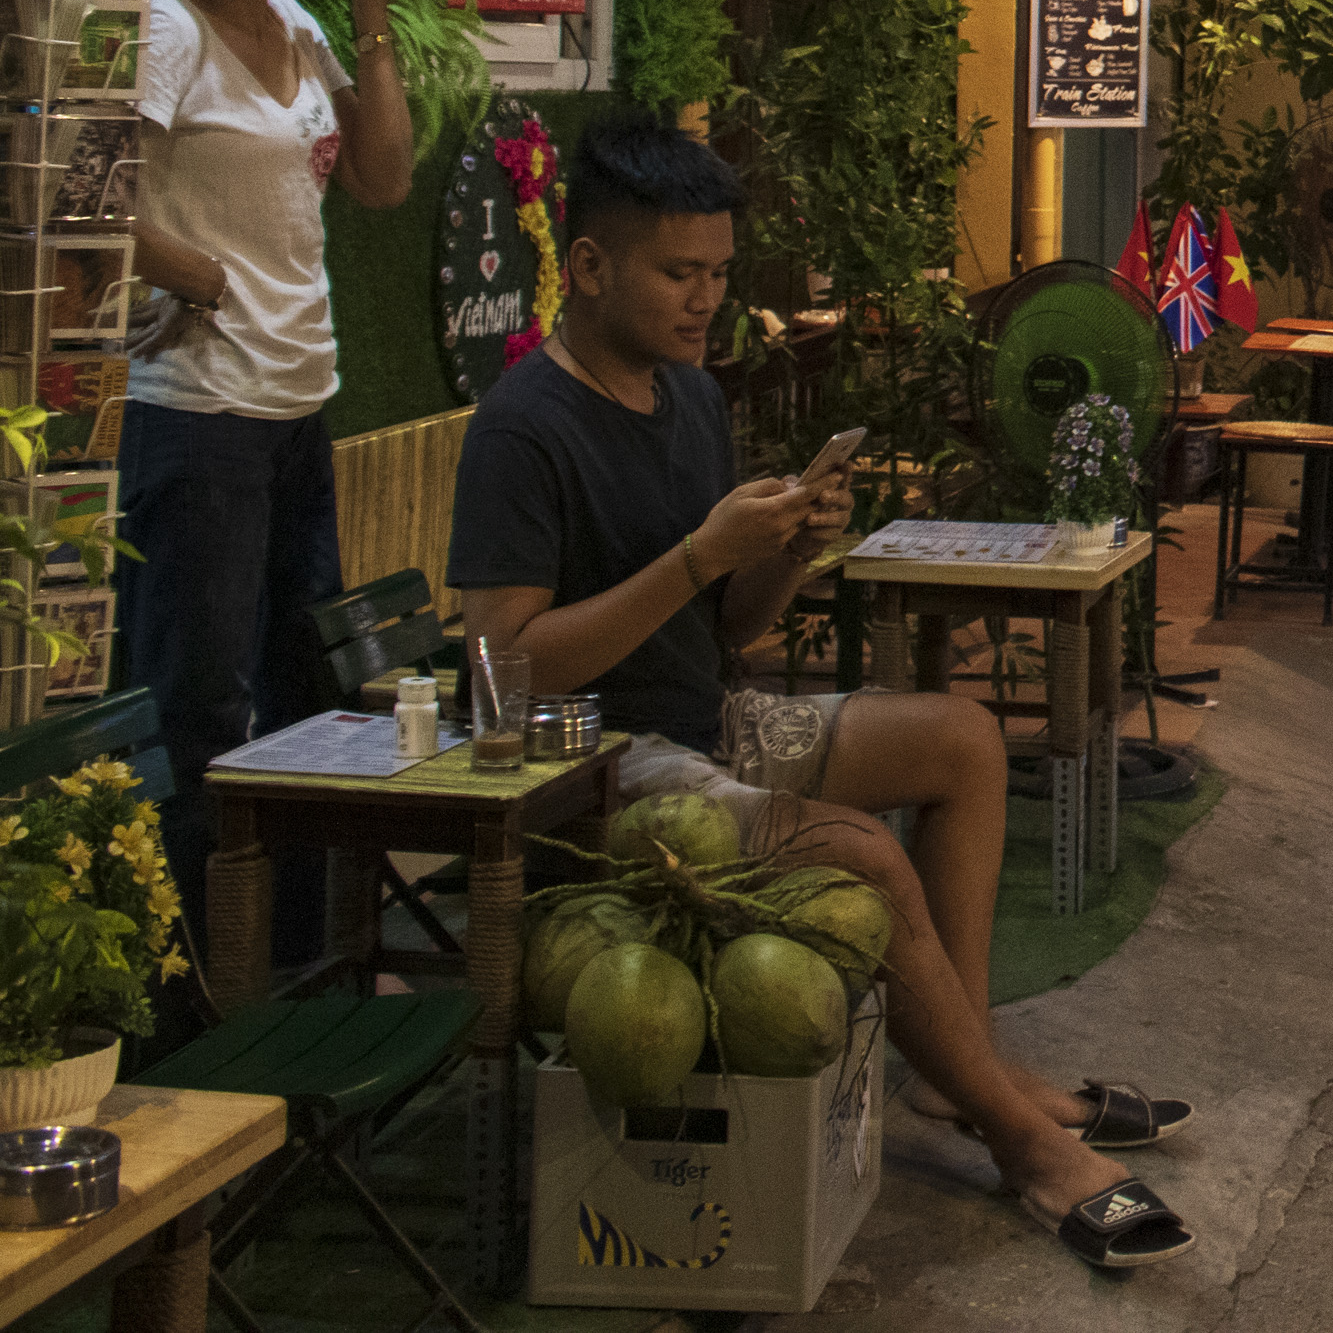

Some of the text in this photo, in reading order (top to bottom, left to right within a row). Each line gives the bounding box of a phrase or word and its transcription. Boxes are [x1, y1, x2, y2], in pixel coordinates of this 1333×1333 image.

[1042, 83, 1137, 102] Train Station
[482, 198, 495, 241] I
[650, 1158, 711, 1187] Tiger
